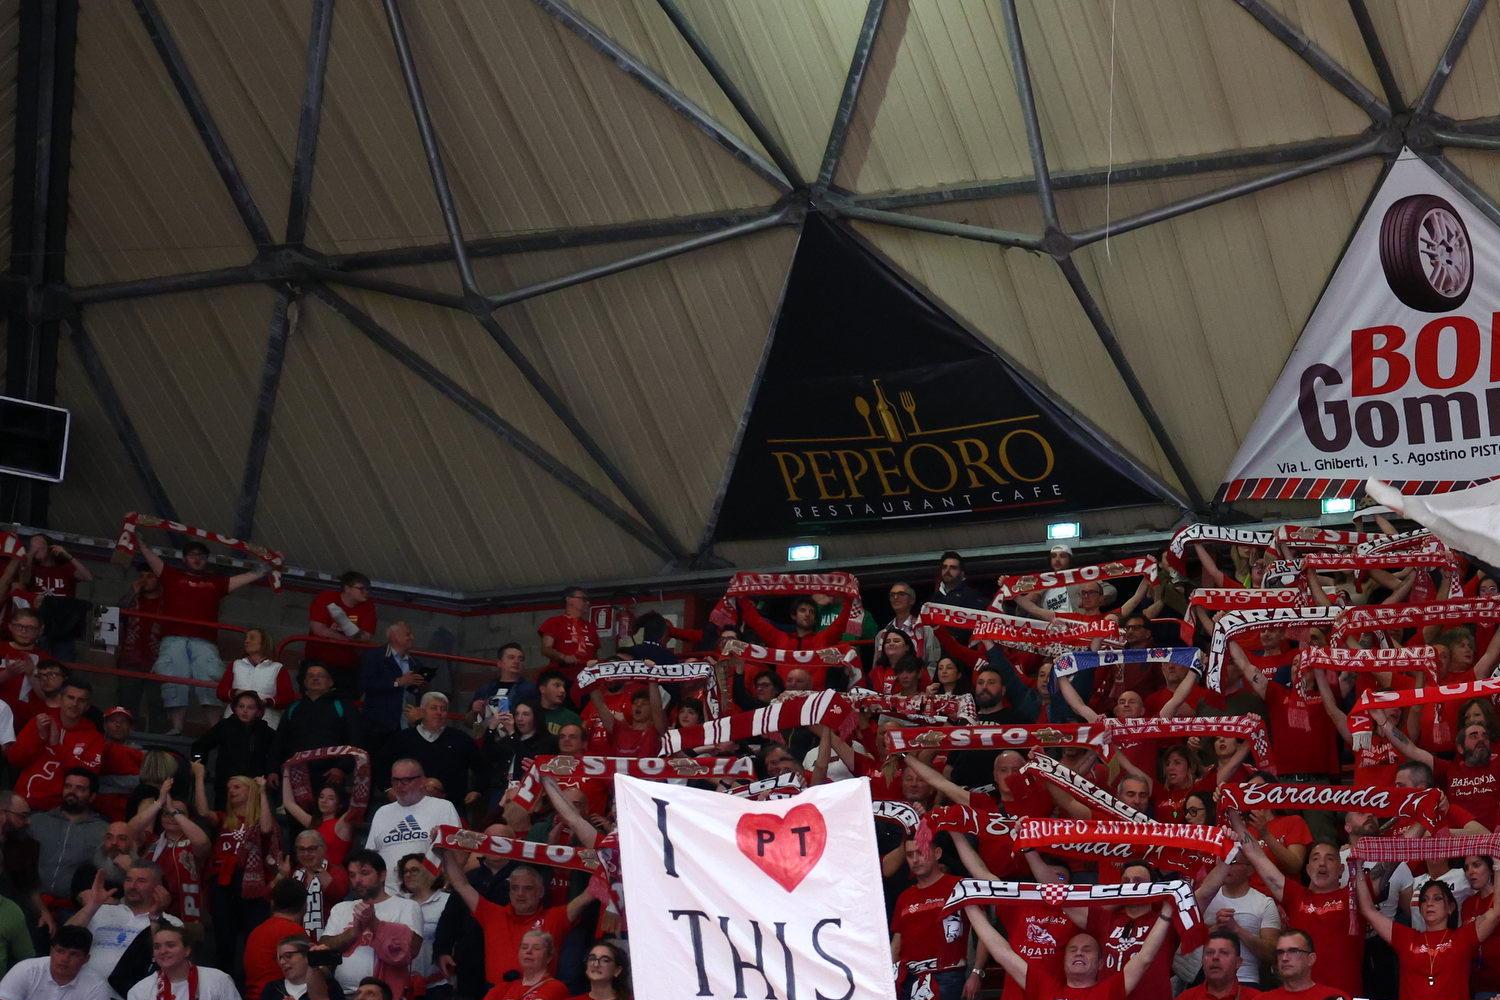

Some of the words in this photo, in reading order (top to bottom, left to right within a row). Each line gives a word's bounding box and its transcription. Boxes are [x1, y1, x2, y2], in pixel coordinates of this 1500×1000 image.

[771, 429, 1056, 502] PEPEORO
[1277, 461, 1298, 475] Via
[1300, 458, 1312, 472] L.
[1314, 454, 1369, 472] Ghiberti,
[1372, 454, 1379, 467] 1
[1392, 451, 1404, 465] S.
[1407, 445, 1467, 466] Agostino
[794, 494, 973, 519] RESTAURANT
[991, 484, 1062, 503] CAFE
[1042, 566, 1100, 588] STO
[751, 645, 815, 661] STO
[950, 727, 1027, 747] STO
[583, 756, 668, 775] STO
[1240, 783, 1391, 808] Baraonda
[383, 829, 429, 844] adidas
[651, 798, 680, 879] I
[1019, 818, 1088, 839] GRUPPO
[490, 835, 575, 863] STO
